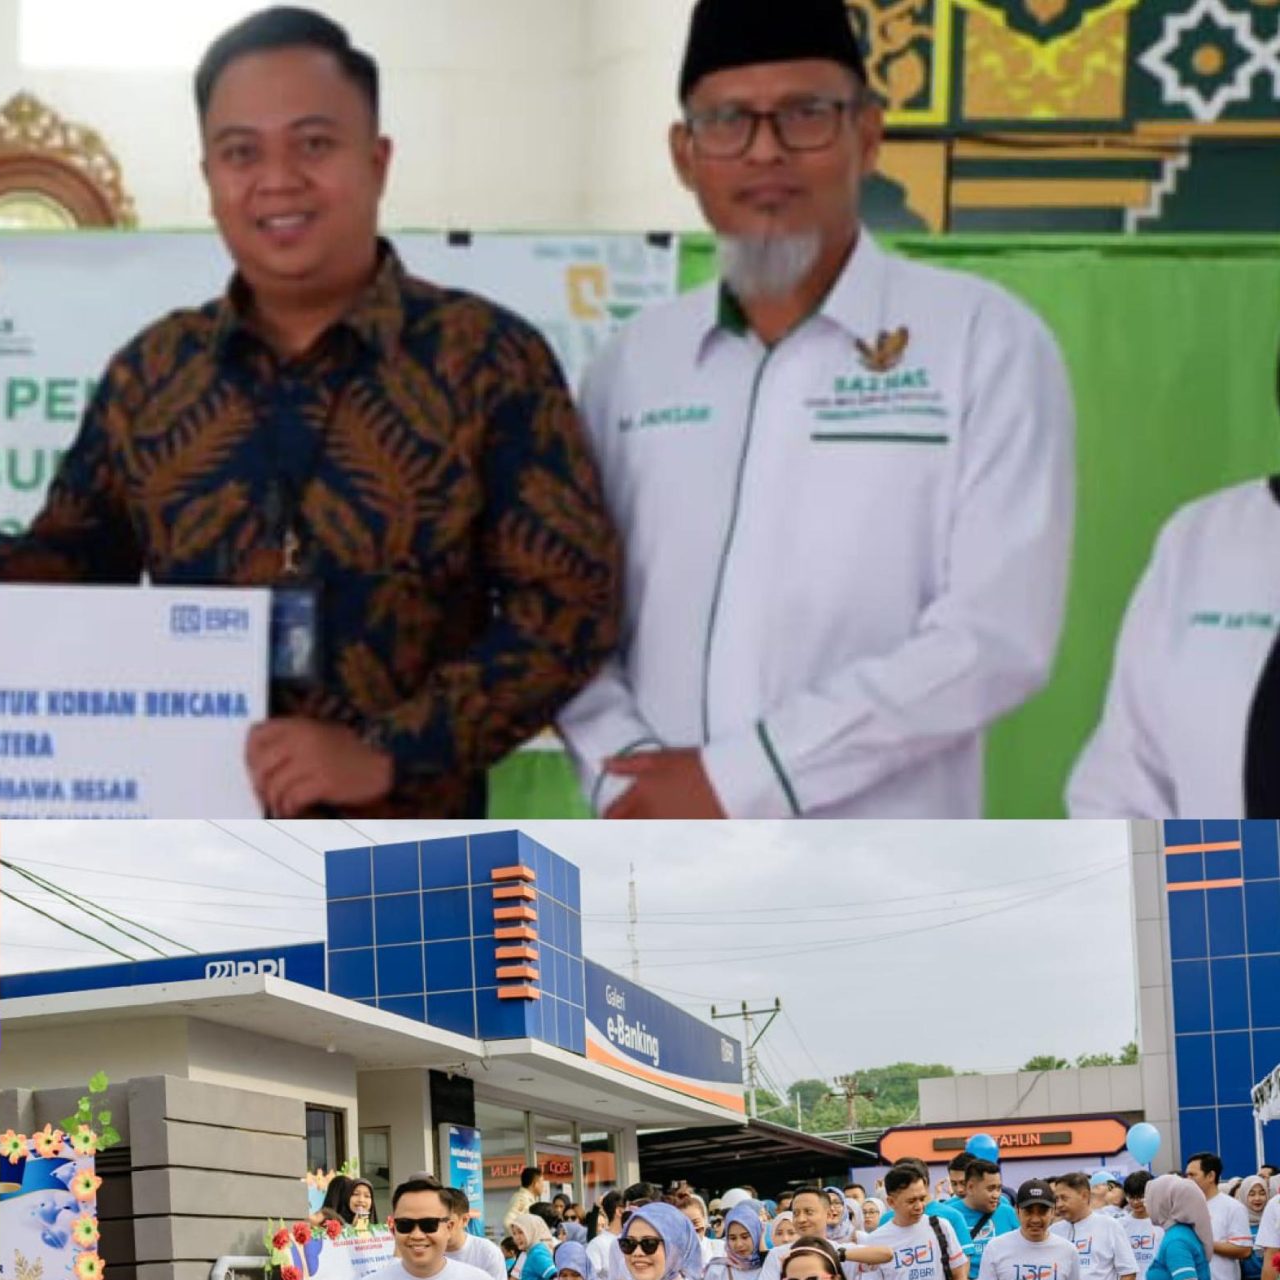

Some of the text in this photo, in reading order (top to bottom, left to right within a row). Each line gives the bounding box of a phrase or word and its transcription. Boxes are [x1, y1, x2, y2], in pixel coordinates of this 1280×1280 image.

[48, 690, 137, 716] KORBAN
[145, 691, 249, 717] BENCANA
[72, 779, 138, 801] BESAR
[605, 984, 626, 1012] Galeri
[606, 1014, 660, 1067] e-Banking
[894, 1242, 934, 1269] 130
